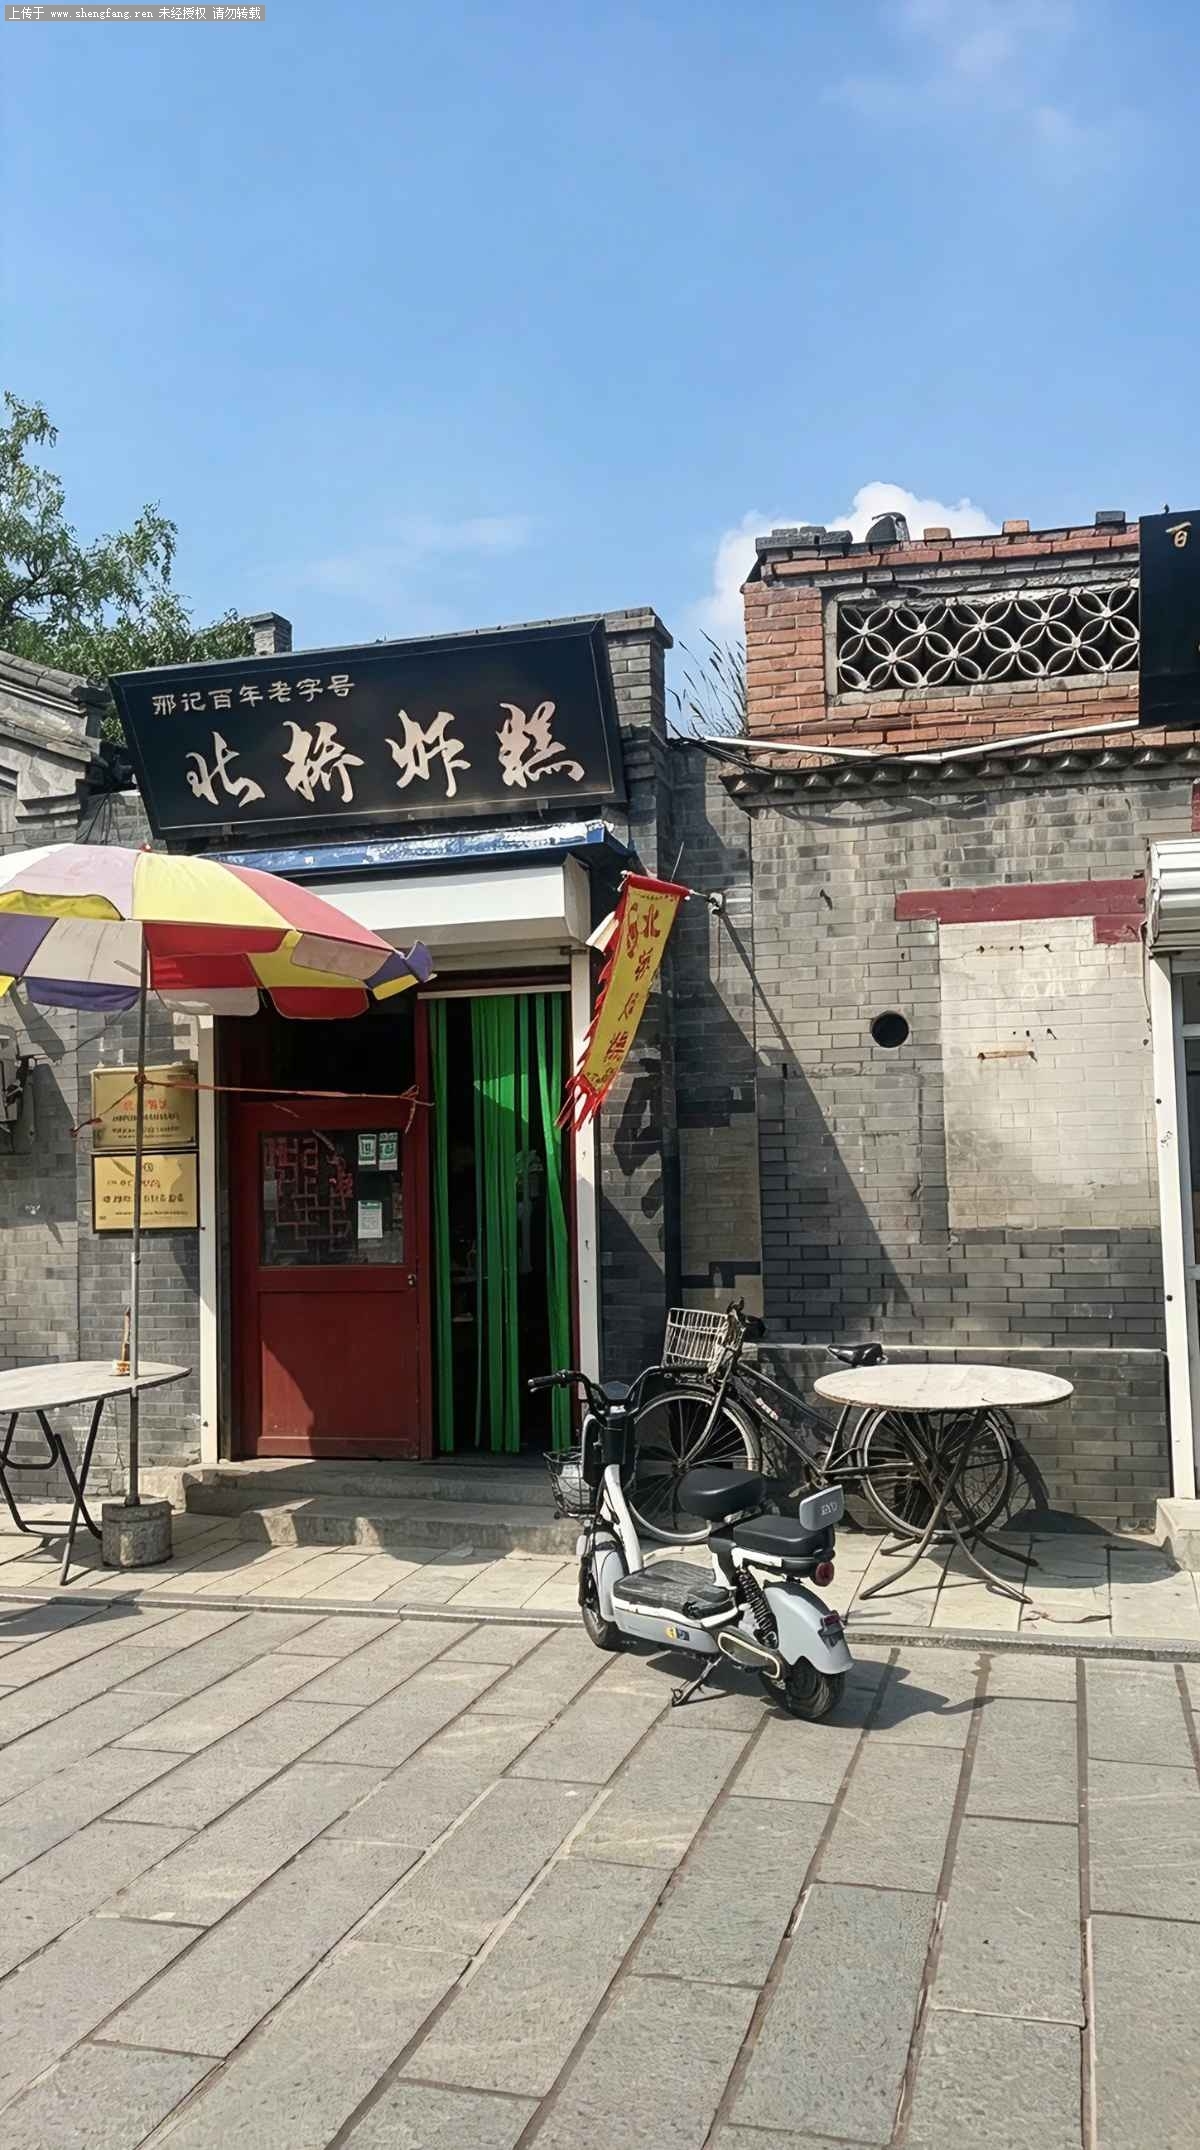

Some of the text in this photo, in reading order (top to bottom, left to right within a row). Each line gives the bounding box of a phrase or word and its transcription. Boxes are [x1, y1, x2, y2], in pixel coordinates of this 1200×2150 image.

[151, 674, 356, 716] 邢记百年老字号
[185, 700, 586, 808] 北桥炸糕
